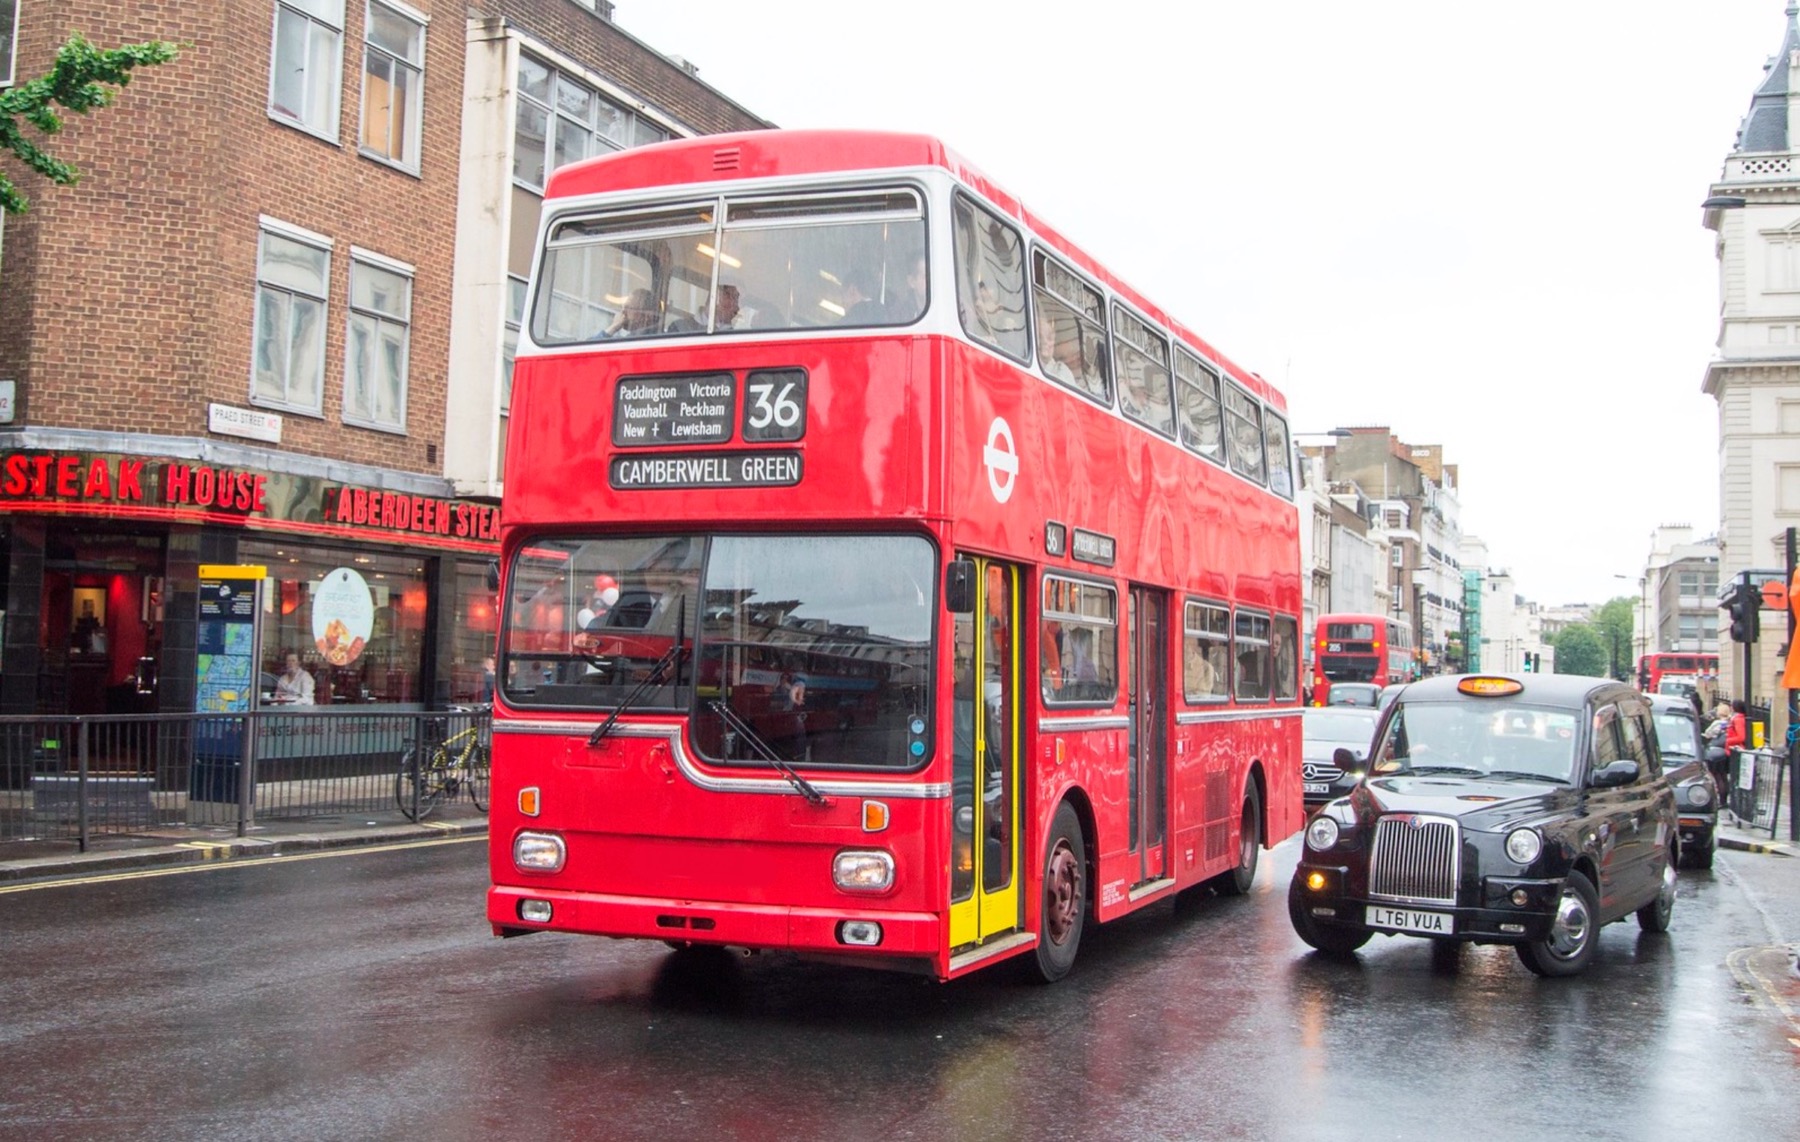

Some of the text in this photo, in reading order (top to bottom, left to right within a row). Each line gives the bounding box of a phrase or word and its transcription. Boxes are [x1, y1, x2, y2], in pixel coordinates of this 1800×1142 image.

[620, 383, 730, 401] Paddington Victoria
[624, 402, 725, 418] Vauxhall Peckham
[749, 383, 800, 428] 36
[214, 407, 238, 423] PRAED
[240, 412, 265, 427] STREET
[624, 423, 646, 437] New
[672, 421, 721, 436] Lewisham
[620, 457, 798, 483] CAMBERWELL GREEN
[5, 454, 268, 512] STEAK HOUSE
[336, 486, 450, 534] ABERDEEN
[1375, 909, 1442, 930] LT61 VUA
